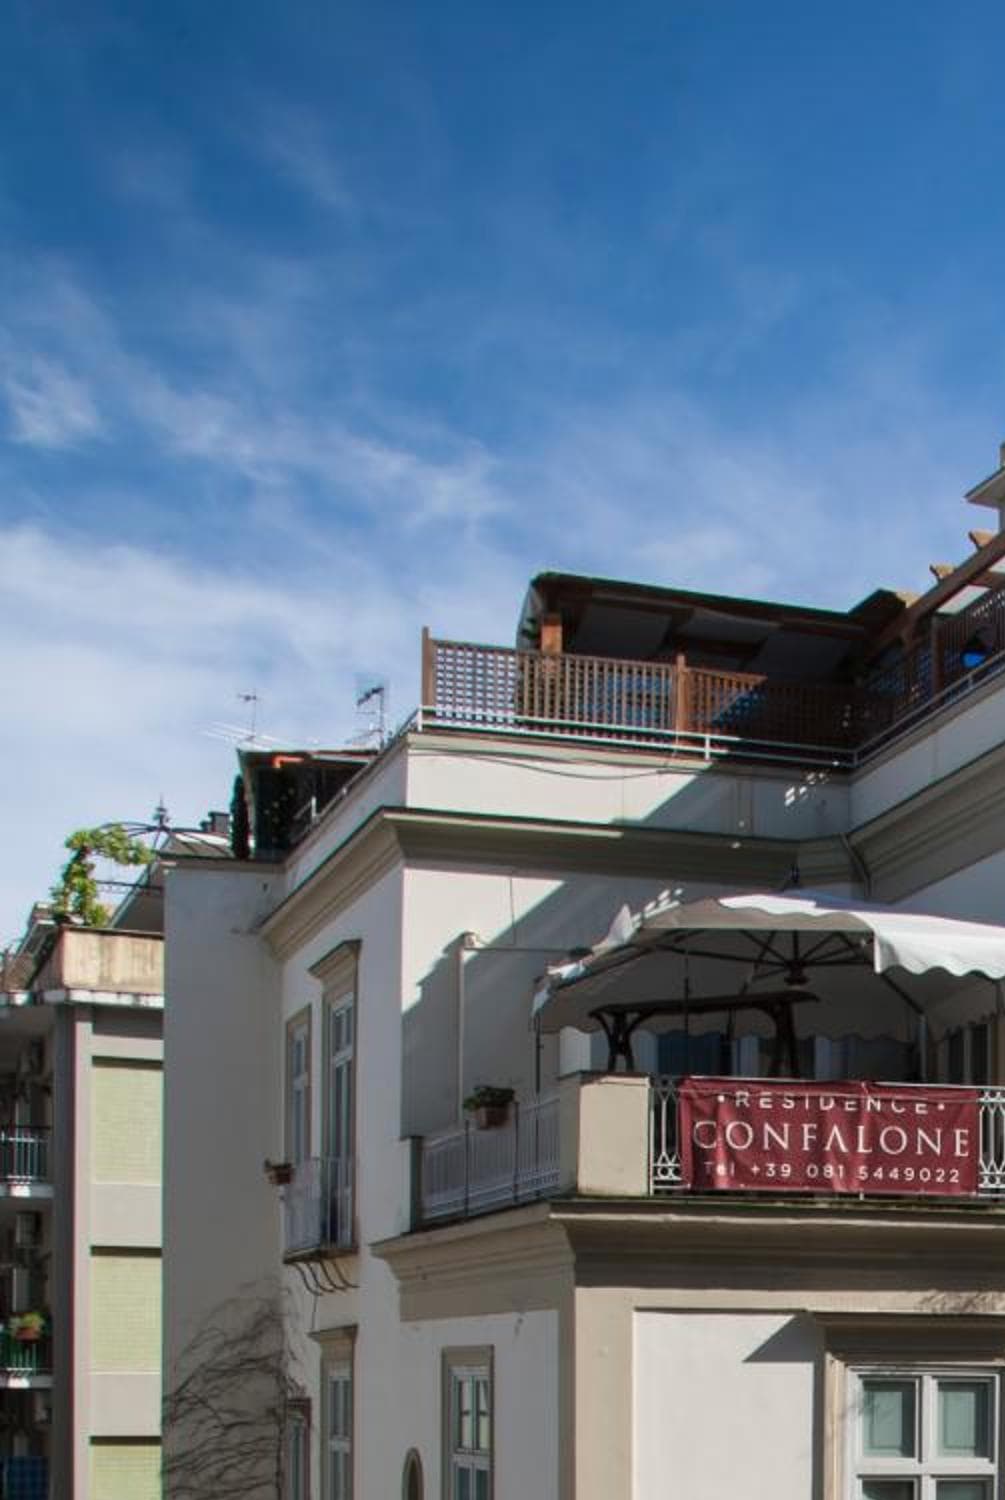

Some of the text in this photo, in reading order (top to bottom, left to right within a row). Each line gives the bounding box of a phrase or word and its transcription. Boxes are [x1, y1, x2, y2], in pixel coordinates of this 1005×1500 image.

[735, 1091, 928, 1115] RESIDENCE
[693, 1120, 970, 1158] CONFALONE
[751, 1163, 791, 1178] +39
[807, 1164, 844, 1179] 081
[858, 1165, 960, 1183] 5449022
